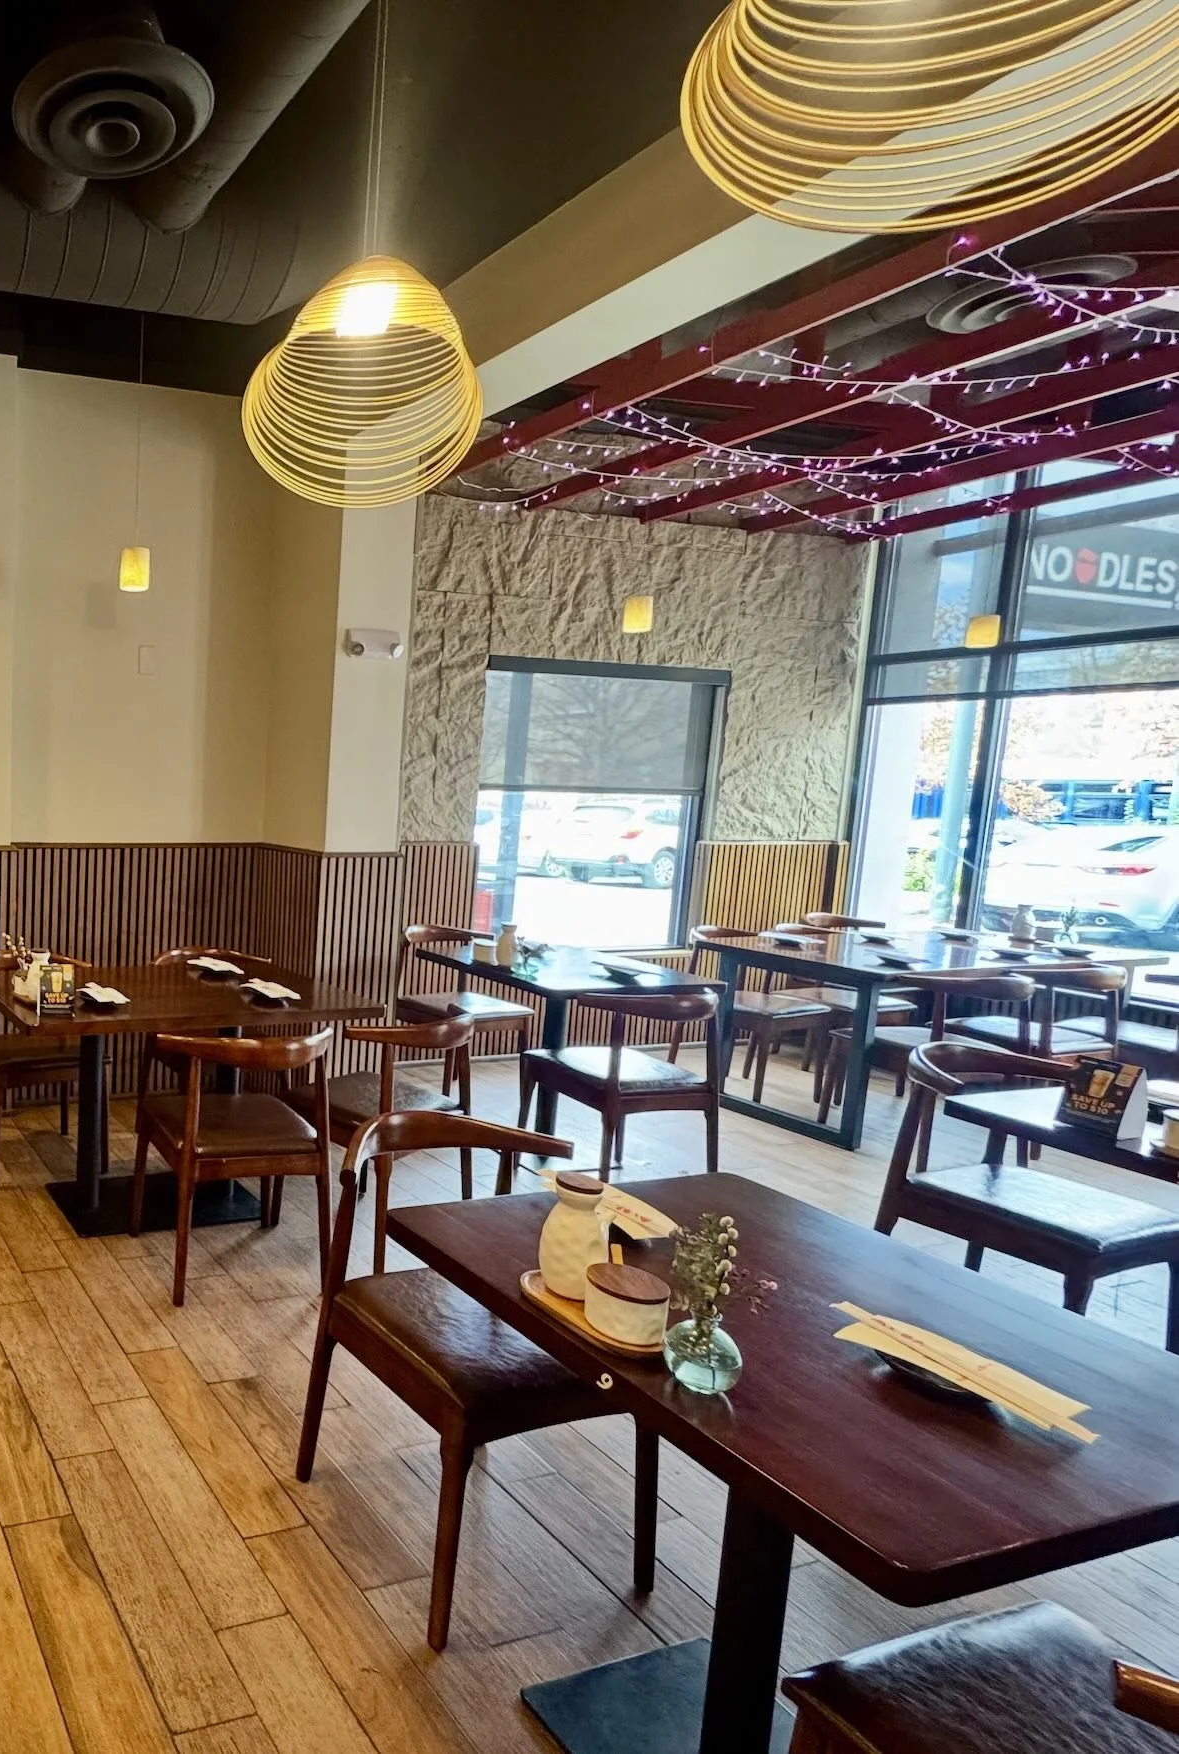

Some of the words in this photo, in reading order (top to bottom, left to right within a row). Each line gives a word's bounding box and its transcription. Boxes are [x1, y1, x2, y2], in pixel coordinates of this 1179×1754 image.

[1071, 1093, 1099, 1105] SAVE
[1100, 1101, 1115, 1109] UP
[1074, 1101, 1088, 1110] TO
[1089, 1105, 1109, 1115] $10
[595, 1372, 614, 1390] 9
